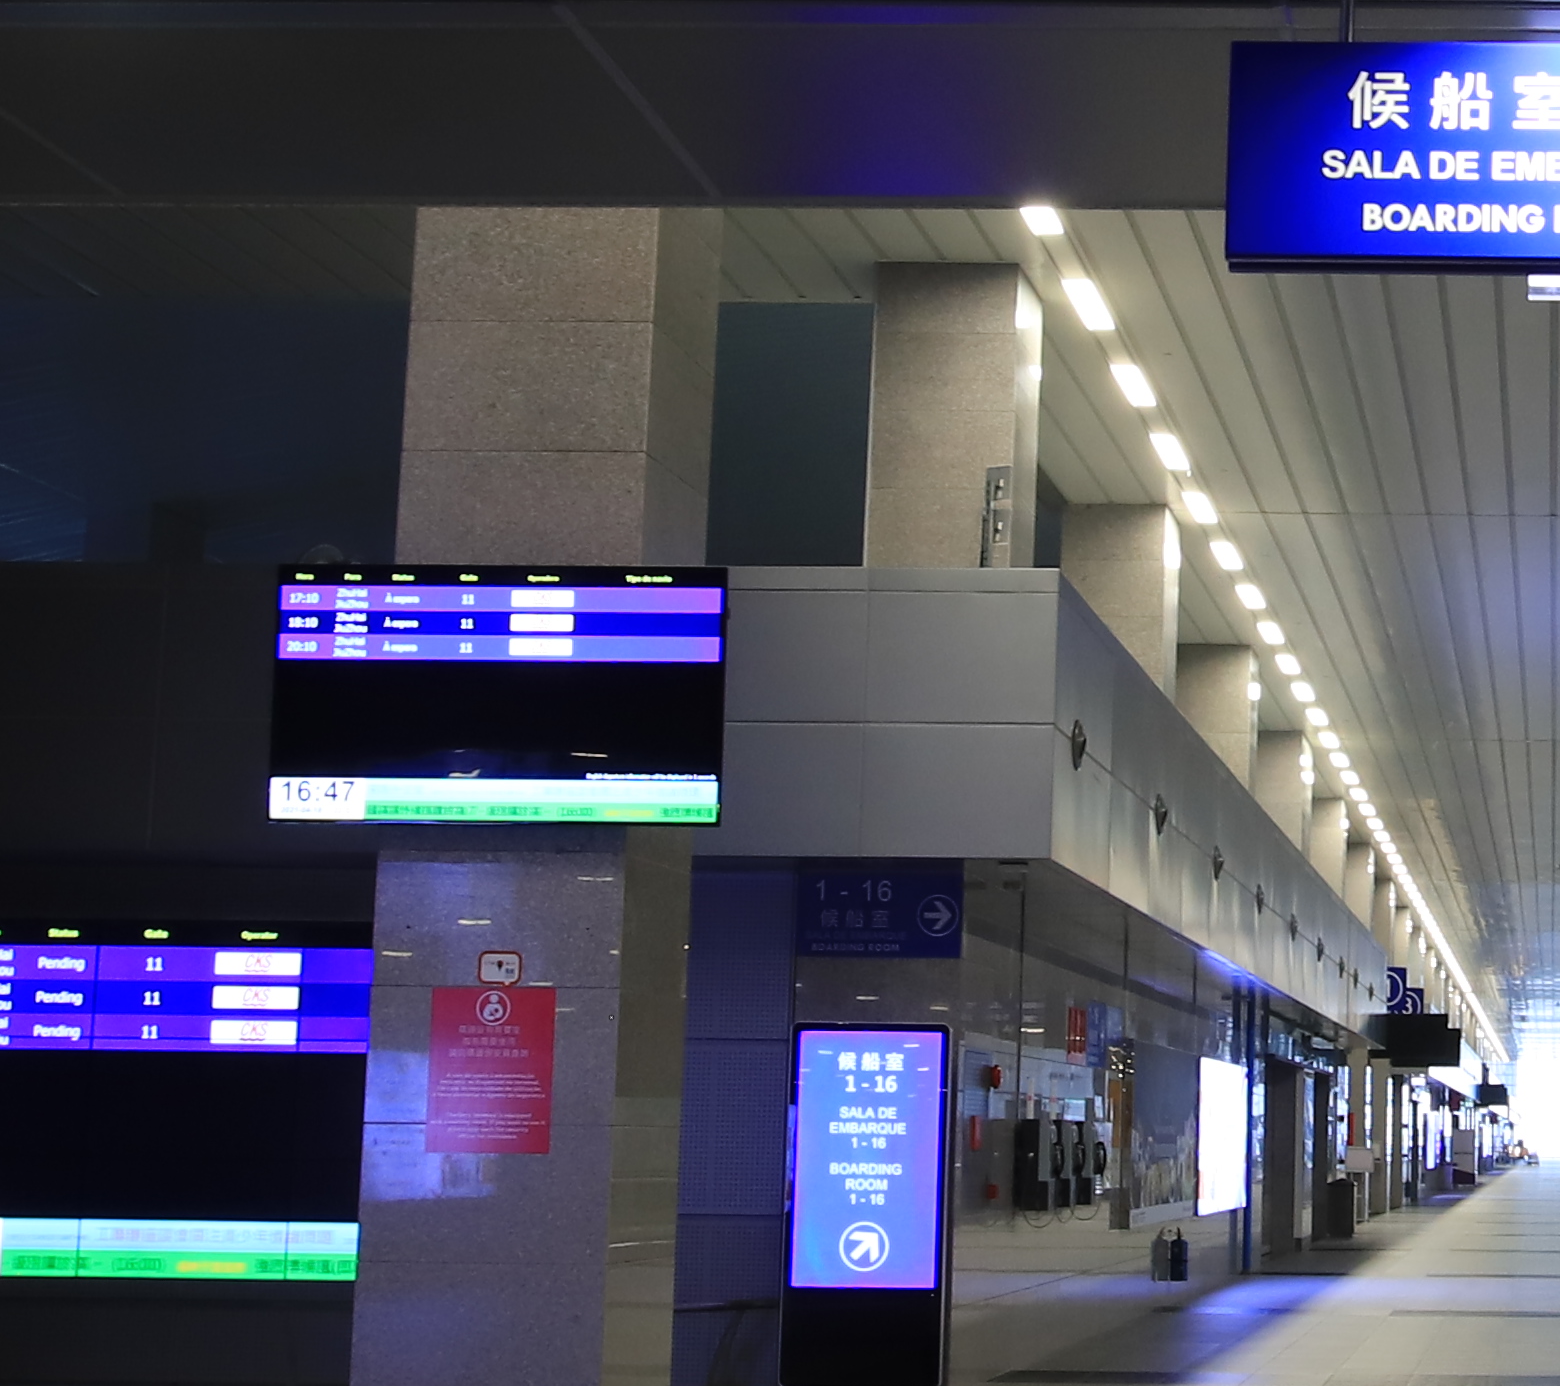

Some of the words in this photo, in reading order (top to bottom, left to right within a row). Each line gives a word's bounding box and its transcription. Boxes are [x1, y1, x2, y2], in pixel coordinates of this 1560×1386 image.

[1321, 149, 1421, 180] SALA
[1429, 150, 1480, 181] DE
[1362, 202, 1545, 233] BOARDING
[289, 592, 320, 604] 17:10
[461, 594, 475, 605] 11
[288, 616, 318, 628] 18:10
[460, 618, 474, 629] 11
[286, 641, 318, 652] 20:10
[459, 642, 473, 653] 11
[282, 781, 355, 801] 16:47
[820, 909, 889, 928] 候船室
[811, 943, 864, 951] BOARDING
[868, 943, 900, 951] ROOM
[37, 956, 86, 972] Pending
[145, 957, 163, 971] 11
[35, 991, 84, 1006] Pending
[143, 991, 161, 1005] 11
[33, 1025, 81, 1041] Pending
[141, 1025, 159, 1039] 11
[837, 1051, 904, 1071] 候船室
[839, 1106, 875, 1119] SALA
[878, 1107, 897, 1119] DE
[829, 1122, 906, 1135] EMBARQUE
[829, 1162, 902, 1175] BOARDING
[845, 1178, 888, 1191] ROOM
